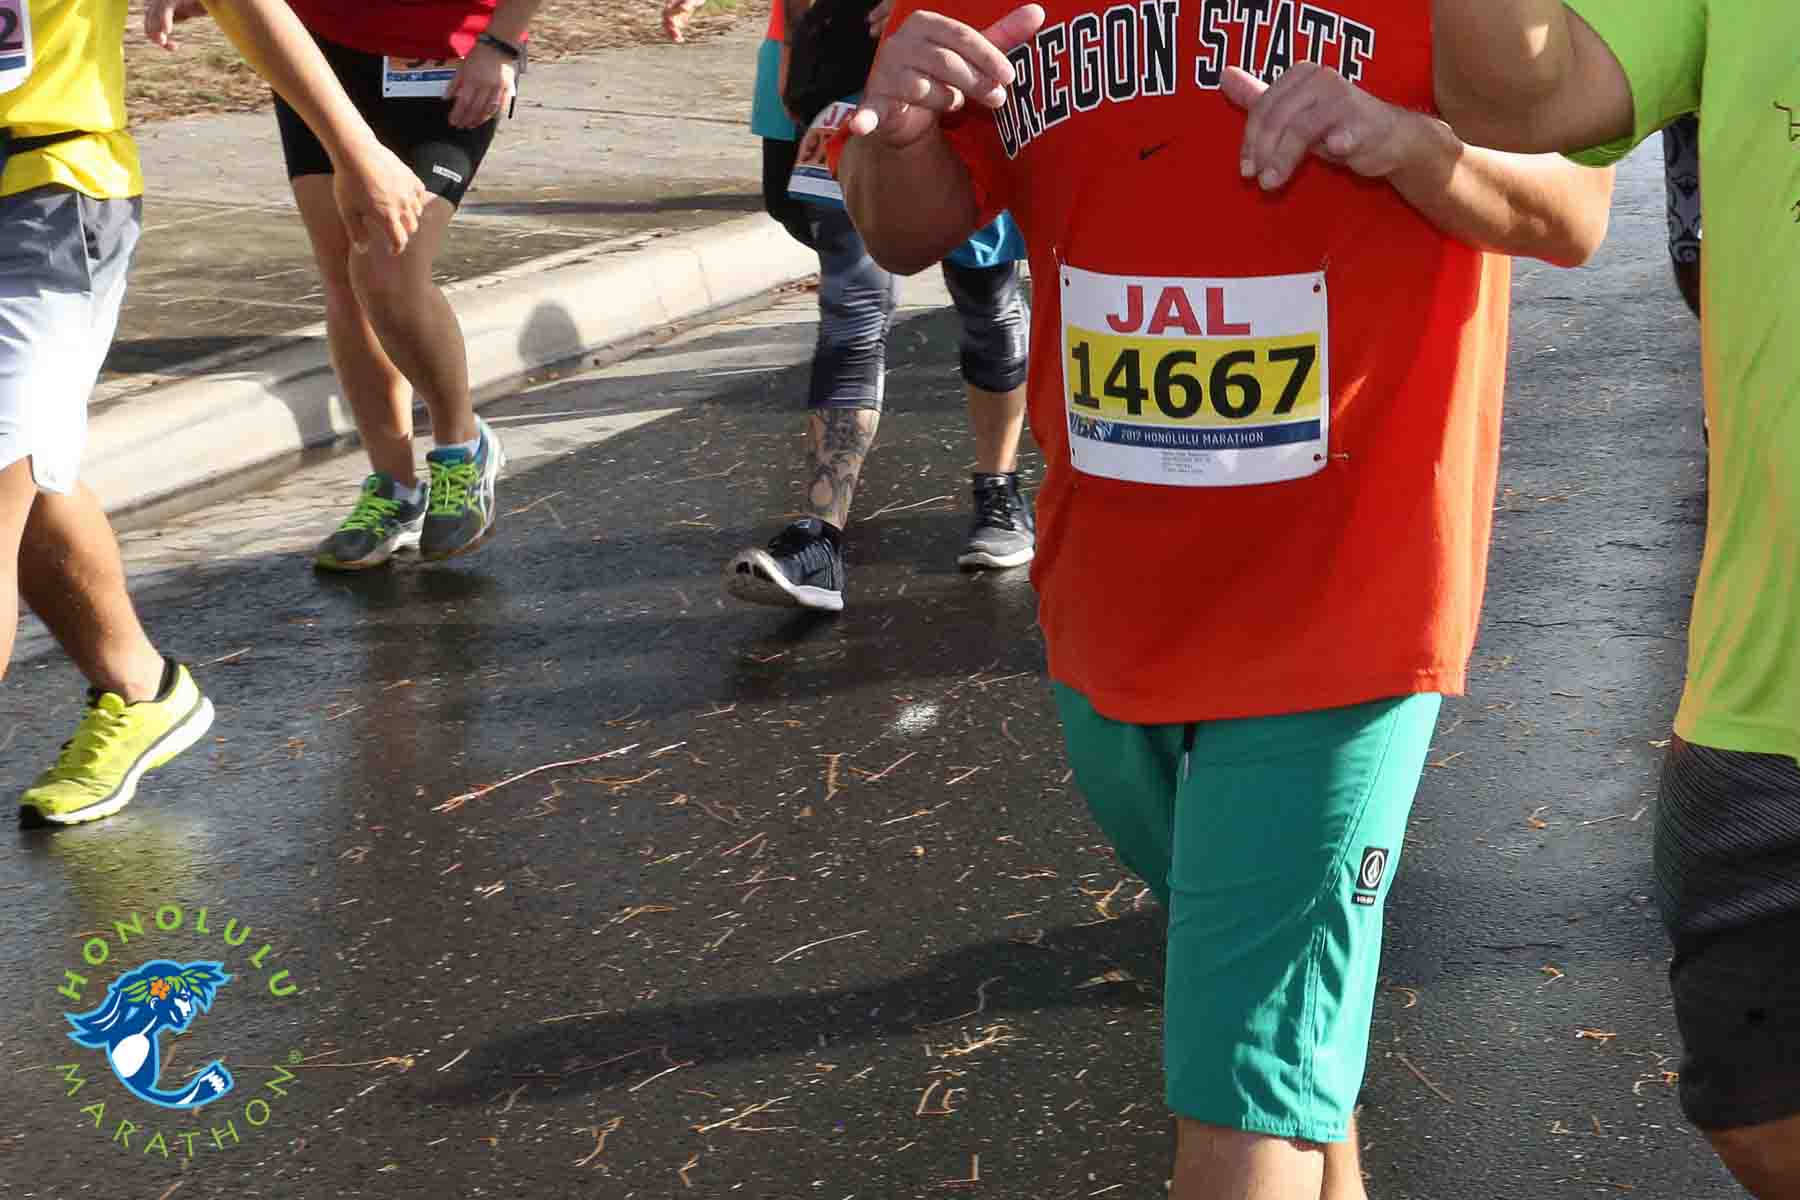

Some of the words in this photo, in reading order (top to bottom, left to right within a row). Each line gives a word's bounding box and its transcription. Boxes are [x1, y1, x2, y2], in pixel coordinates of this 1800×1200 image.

[1105, 284, 1251, 336] JAL
[1071, 341, 1316, 420] 14667
[1120, 431, 1142, 441] 2017
[1144, 432, 1200, 445] HONOLULU
[1202, 431, 1265, 445] MARATHON
